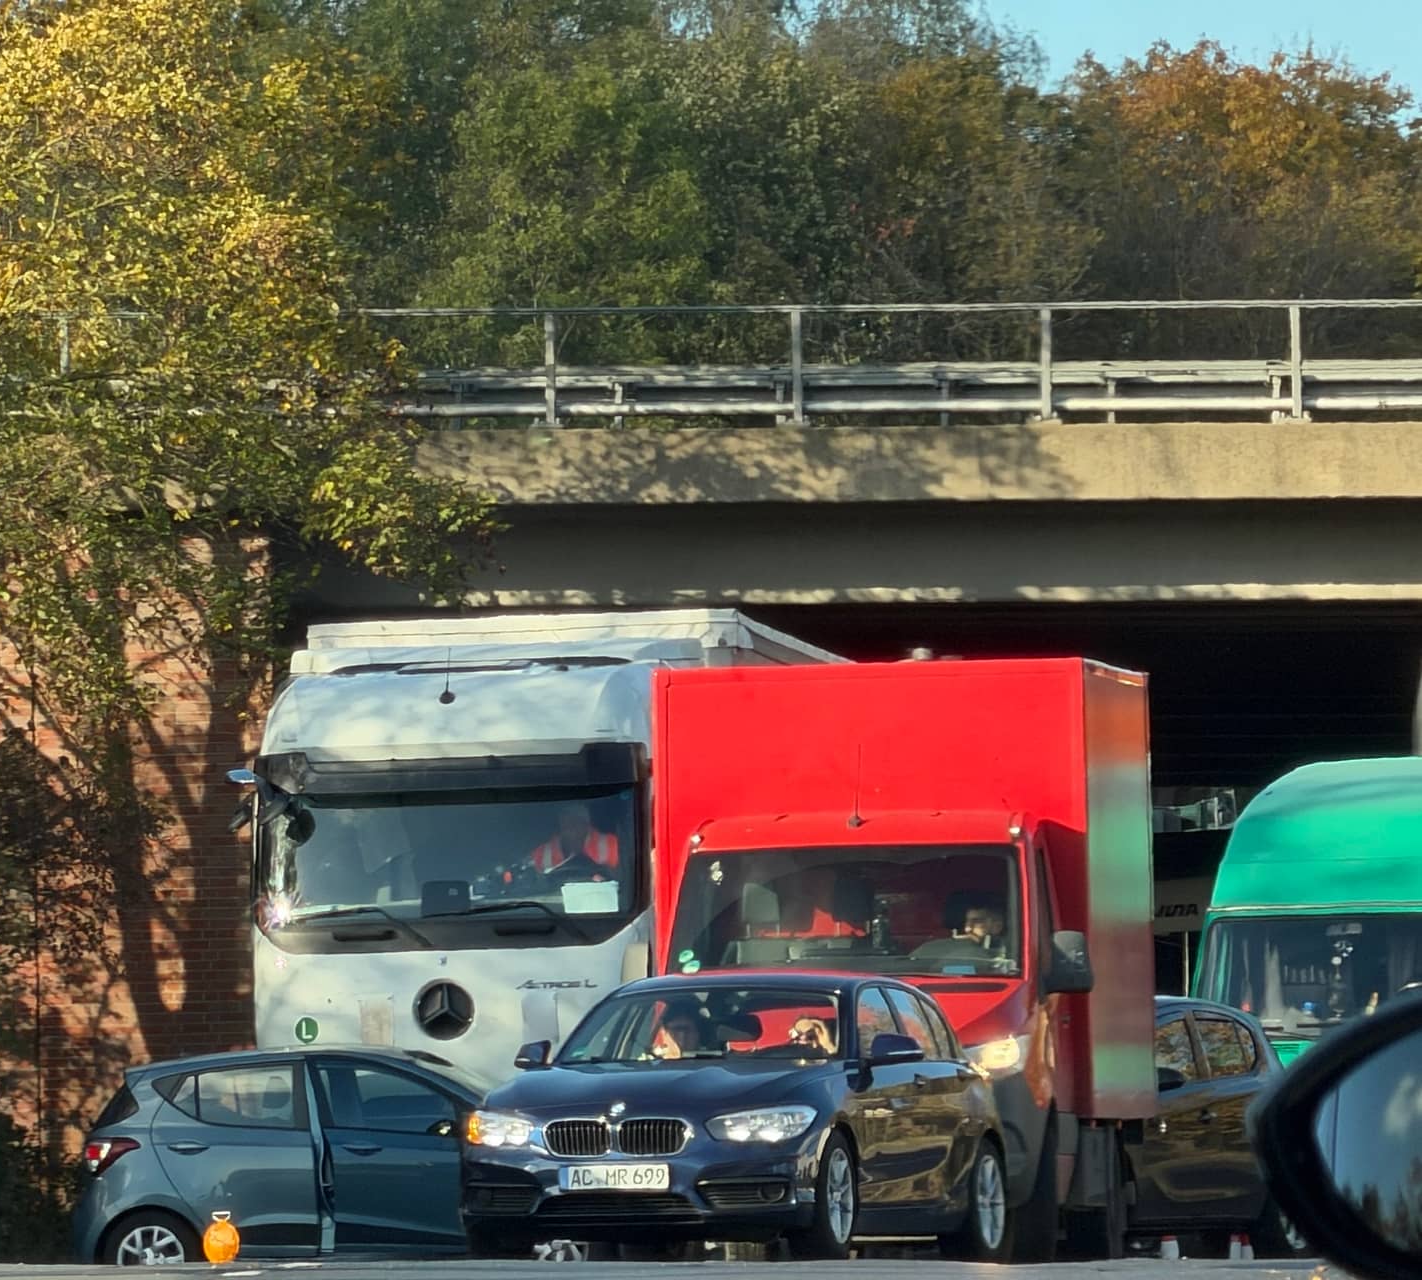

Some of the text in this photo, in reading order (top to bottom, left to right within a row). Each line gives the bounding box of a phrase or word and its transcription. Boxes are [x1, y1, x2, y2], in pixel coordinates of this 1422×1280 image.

[301, 1020, 314, 1039] L
[571, 1168, 665, 1188] AC MR 699
